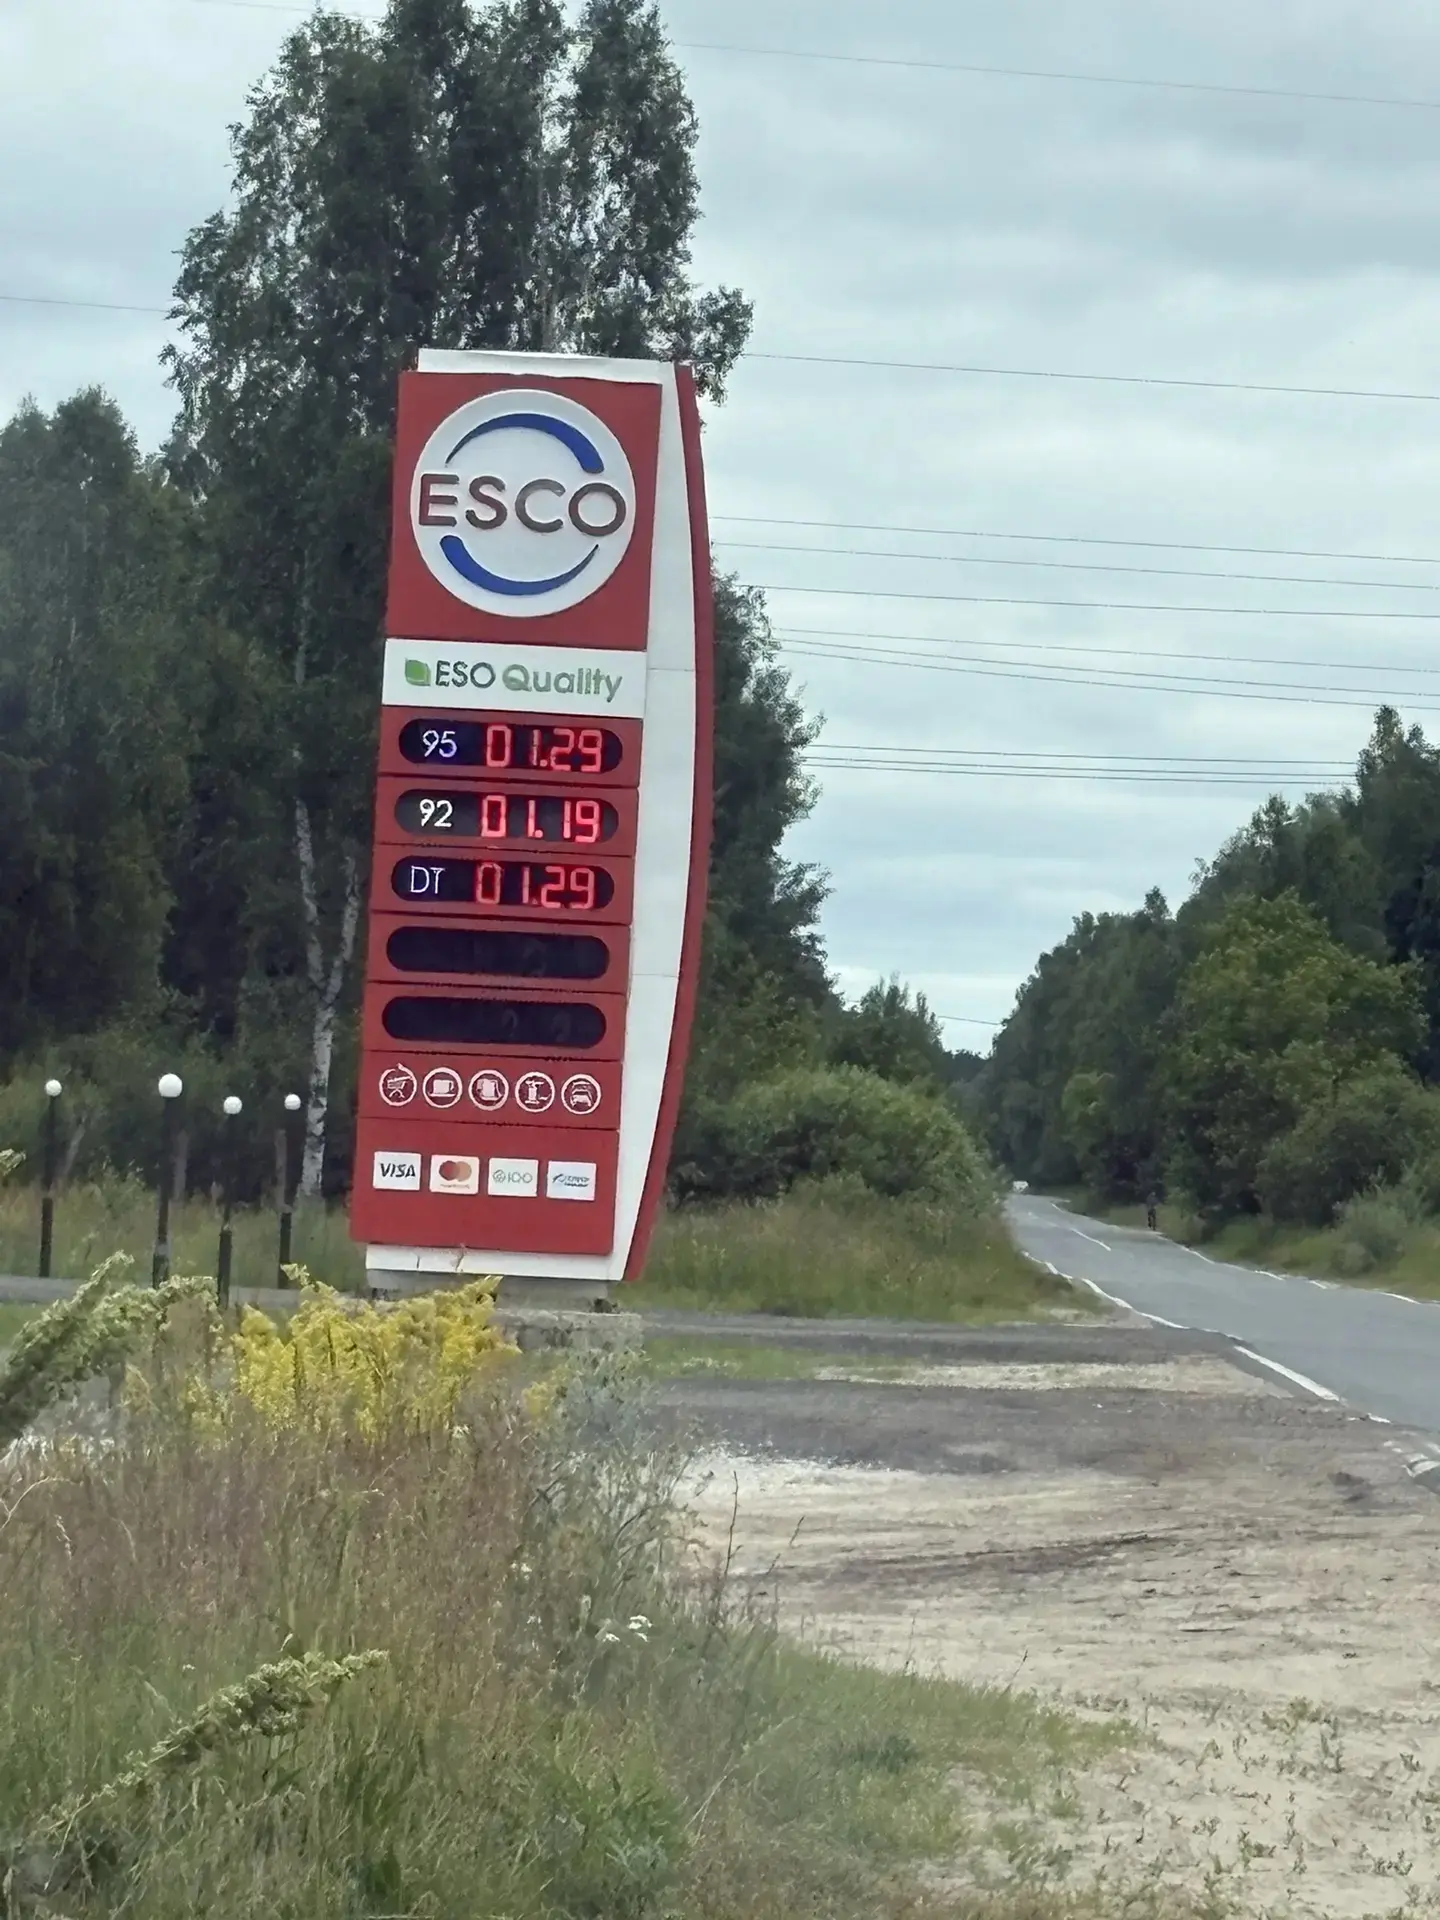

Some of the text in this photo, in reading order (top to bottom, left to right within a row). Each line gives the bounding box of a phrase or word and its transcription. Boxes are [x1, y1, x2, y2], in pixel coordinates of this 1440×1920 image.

[419, 473, 627, 537] ESCO
[502, 664, 622, 703] Quality
[422, 730, 458, 758] 95
[419, 798, 454, 827] 92
[410, 865, 445, 894] DT
[380, 1163, 416, 1178] VISA
